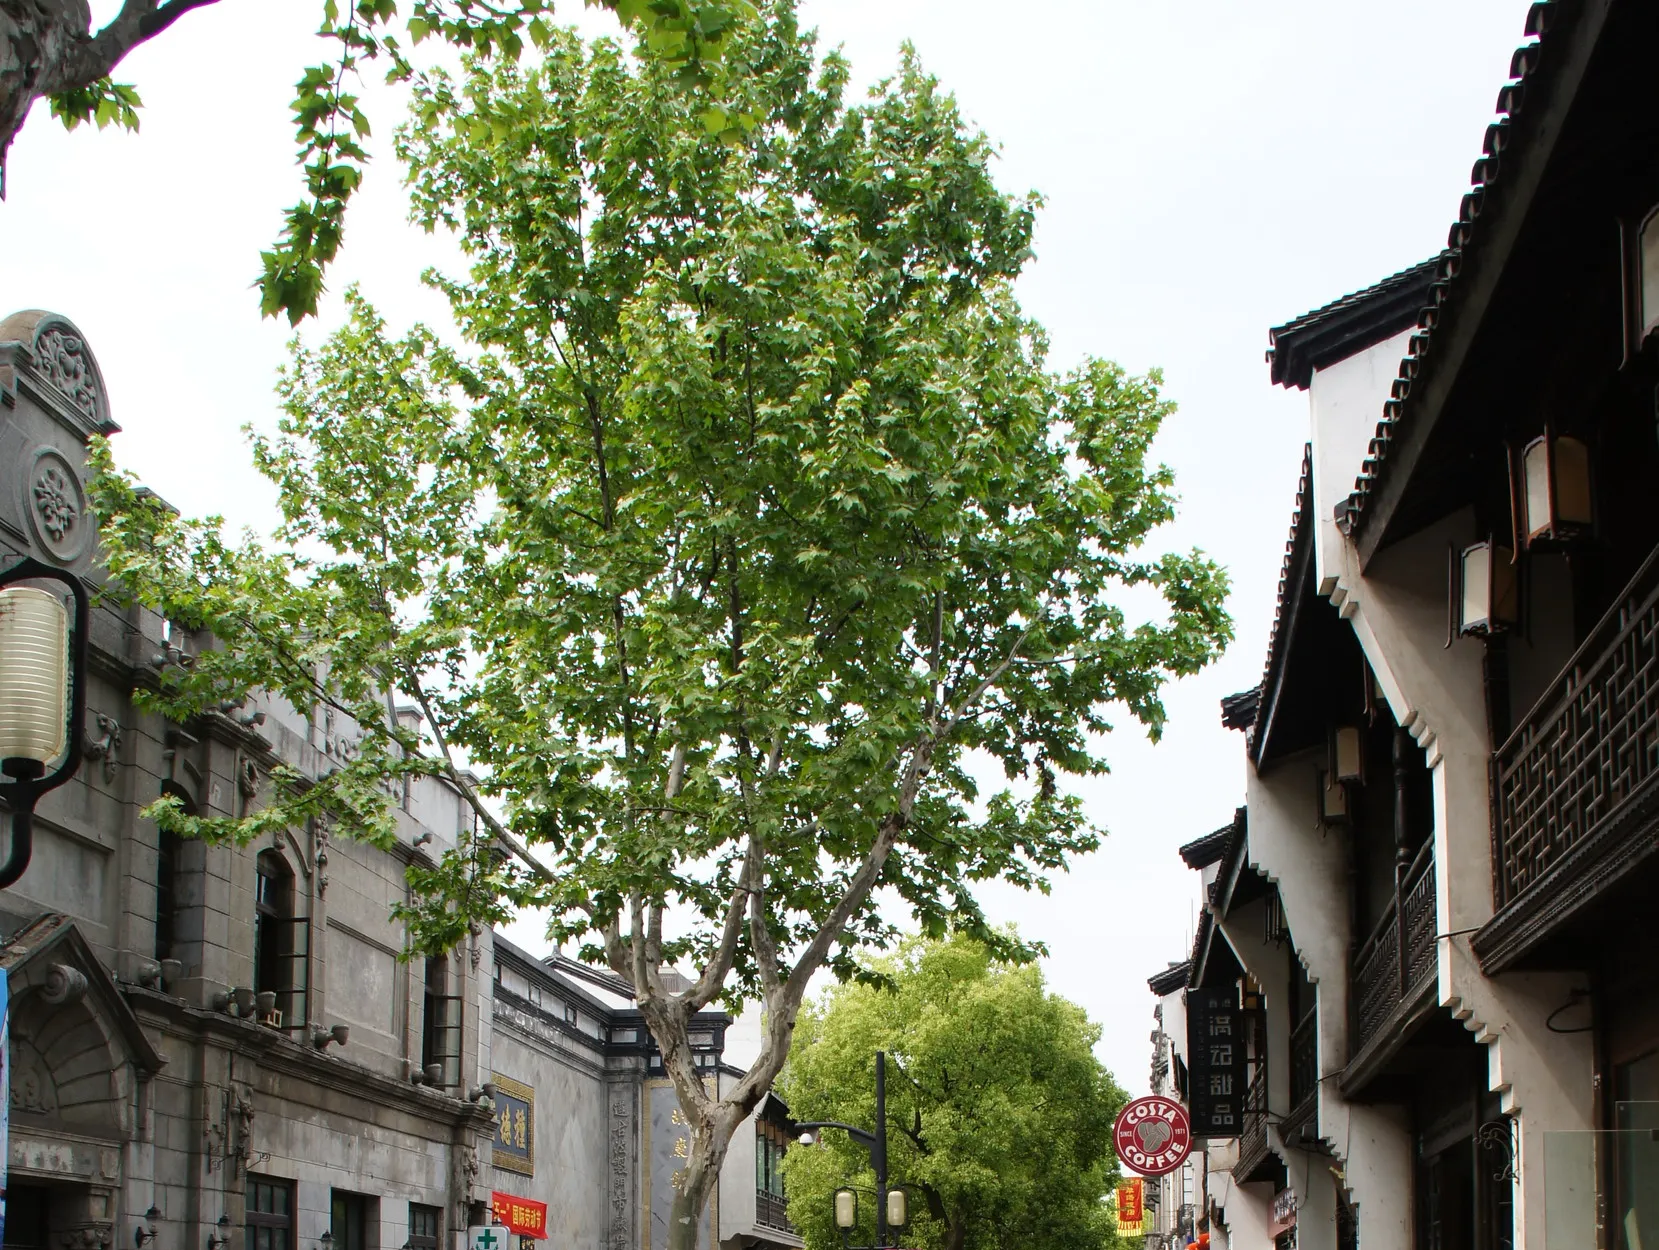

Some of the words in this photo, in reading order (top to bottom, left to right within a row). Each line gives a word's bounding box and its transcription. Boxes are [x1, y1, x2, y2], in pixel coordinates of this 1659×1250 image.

[1126, 1103, 1177, 1125] COSTA
[1119, 1130, 1133, 1138] SINCE
[1125, 1142, 1184, 1169] COFFEE
